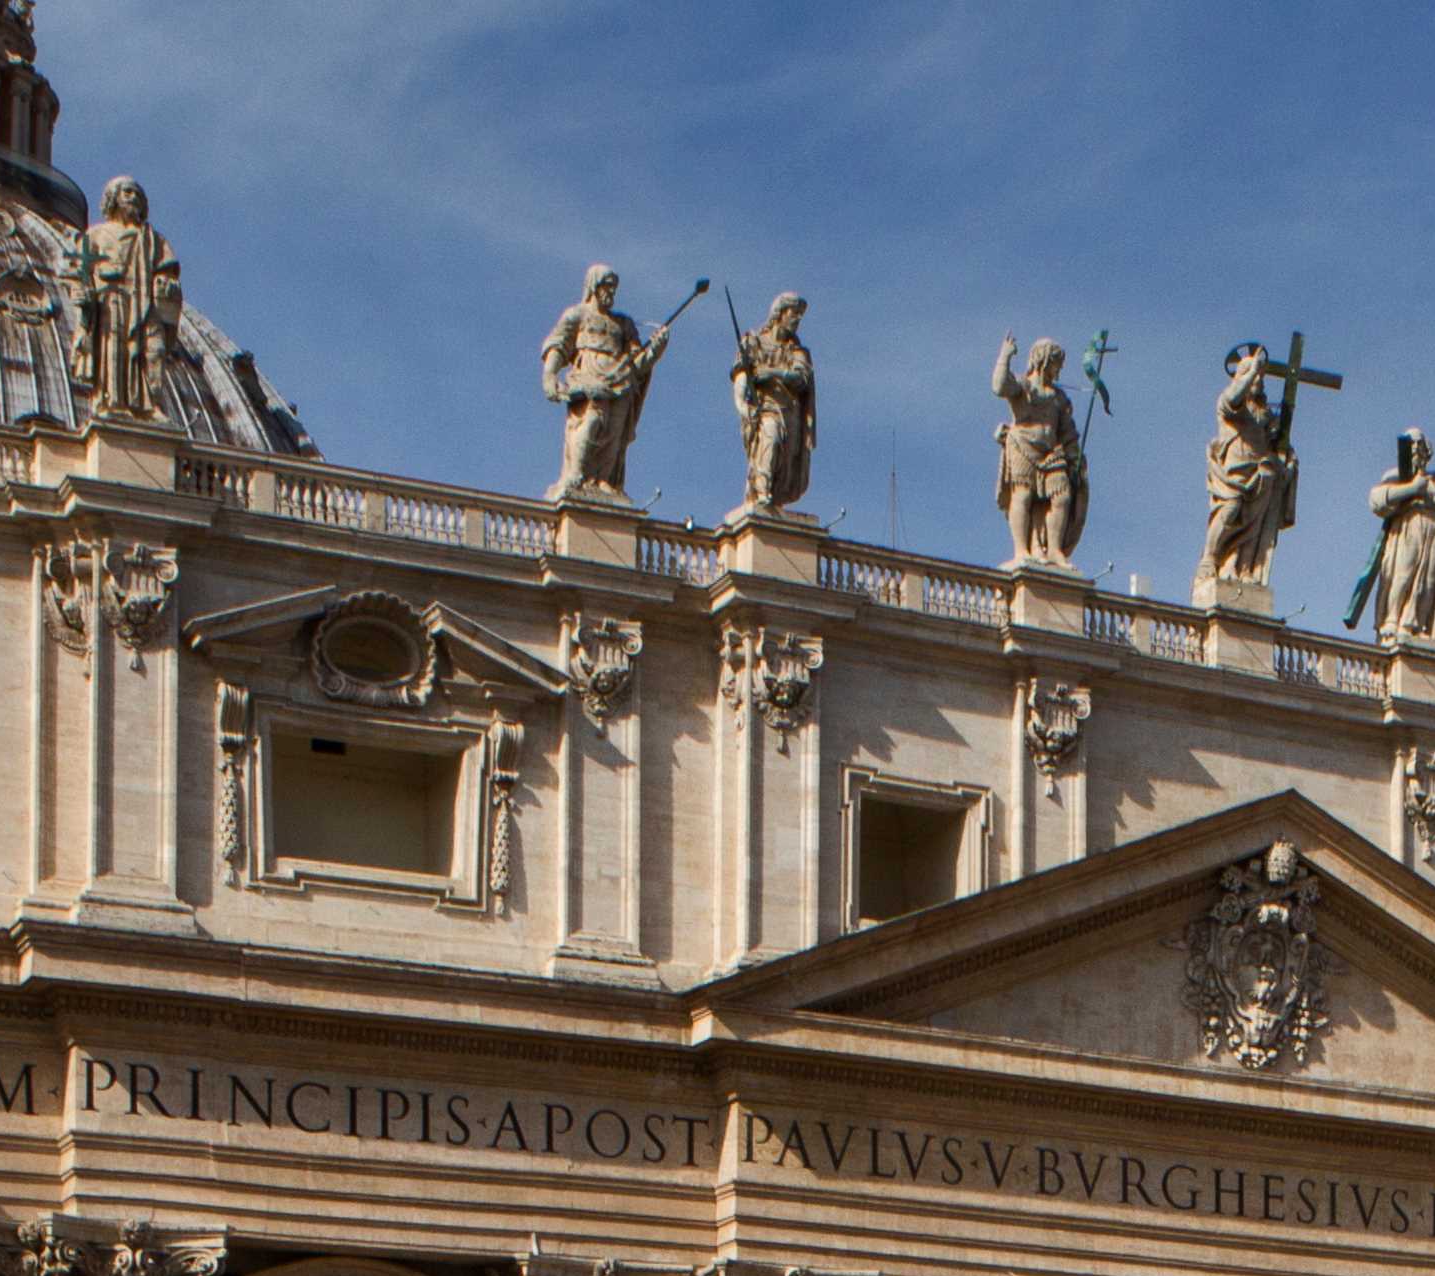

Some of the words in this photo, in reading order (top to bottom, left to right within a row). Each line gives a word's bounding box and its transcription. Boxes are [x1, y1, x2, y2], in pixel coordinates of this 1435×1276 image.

[79, 1058, 471, 1146] PRINCIPIS
[486, 1101, 710, 1168] APOST
[740, 1112, 966, 1186] PAVLVS
[980, 1140, 1015, 1190] V
[1034, 1145, 1411, 1236] BVRGHESIVS
